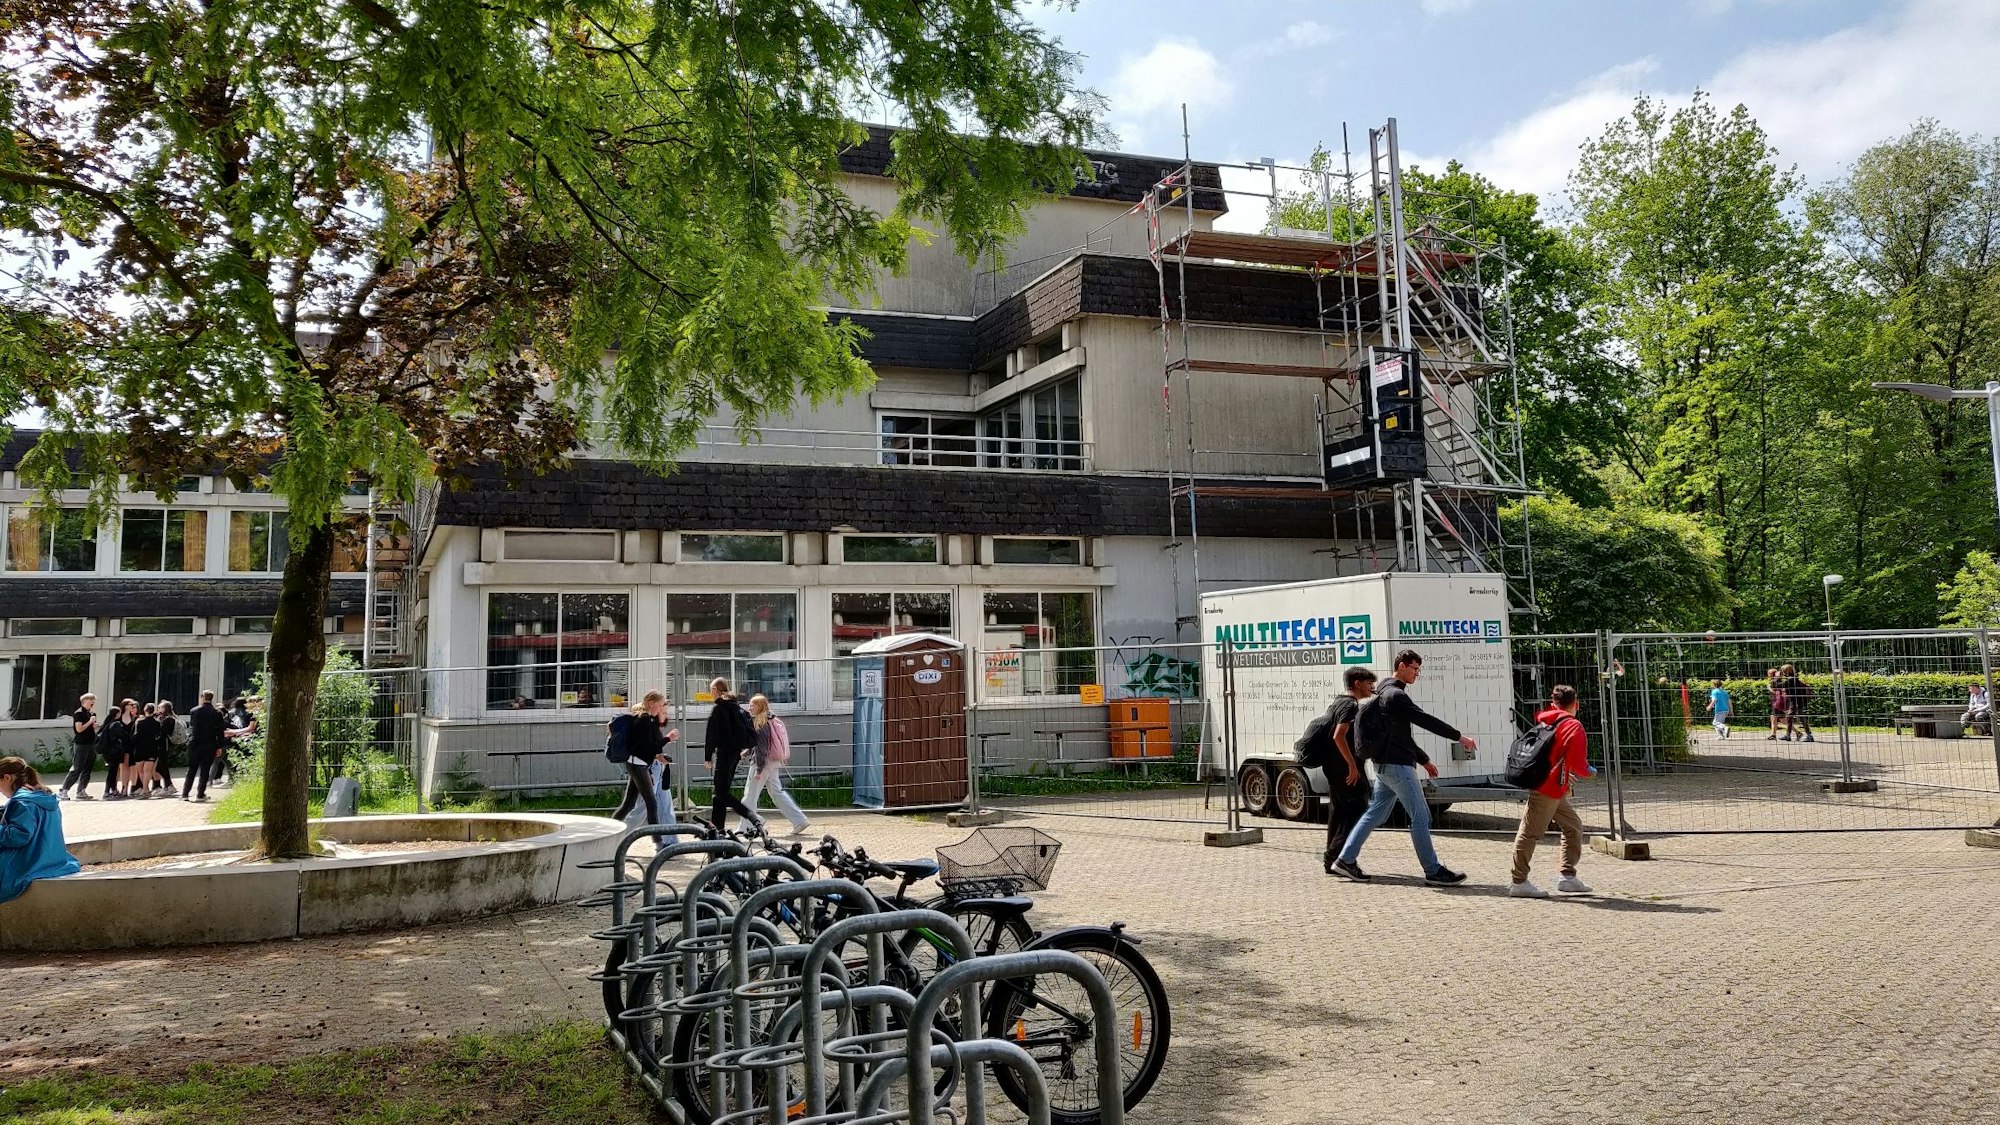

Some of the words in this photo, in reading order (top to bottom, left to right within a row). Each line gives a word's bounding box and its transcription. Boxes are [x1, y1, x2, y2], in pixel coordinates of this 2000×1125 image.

[1216, 617, 1336, 651] MULTITECH
[1399, 620, 1480, 635] MULTITECH
[1302, 650, 1335, 664] GMBH
